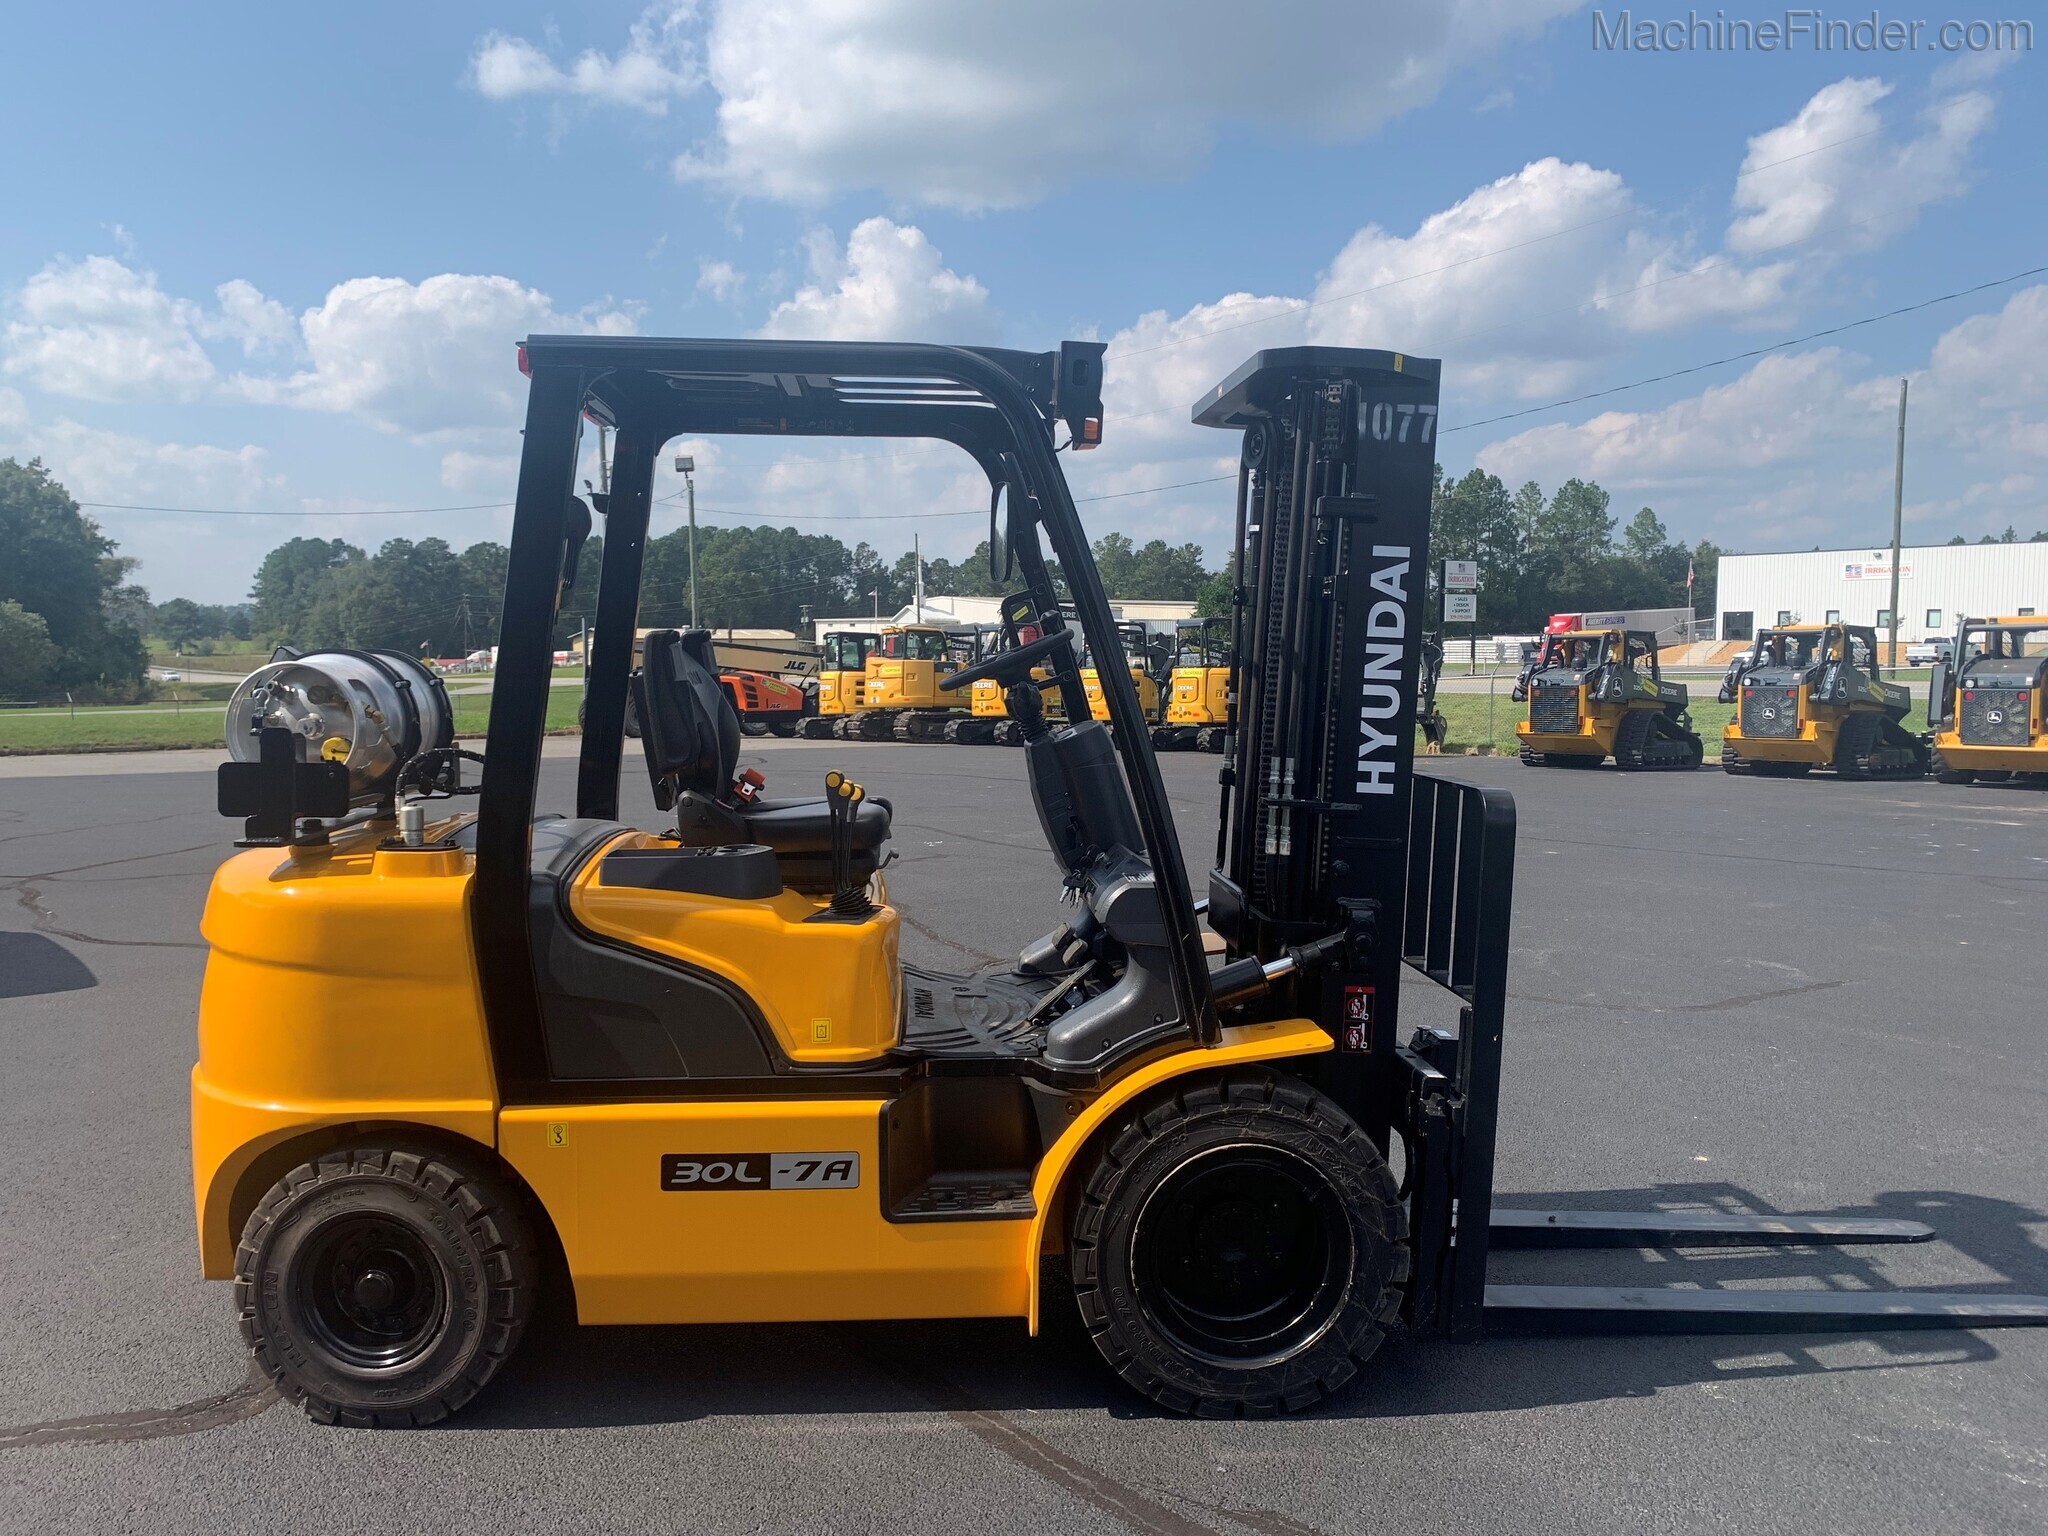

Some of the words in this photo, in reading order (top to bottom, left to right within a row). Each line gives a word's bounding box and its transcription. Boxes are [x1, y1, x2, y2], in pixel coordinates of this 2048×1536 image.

[1358, 402, 1438, 444] 1077
[1864, 565, 1911, 574] IRRIGAON
[1447, 575, 1475, 583] IRRIGATION
[1061, 611, 1077, 619] ERE
[951, 642, 972, 650] DEERE
[783, 660, 807, 671] JLG
[1355, 545, 1411, 795] HYUNDAI
[868, 680, 886, 689] DEERE
[974, 681, 994, 689] DEERE
[1660, 686, 1678, 697] DEERE
[1884, 688, 1902, 700] DEERE
[913, 987, 936, 1020] HYUNDAI
[670, 1160, 763, 1184] 30L
[777, 1159, 854, 1182] -7A
[1111, 1285, 1131, 1318] 700
[462, 1296, 479, 1332] 700
